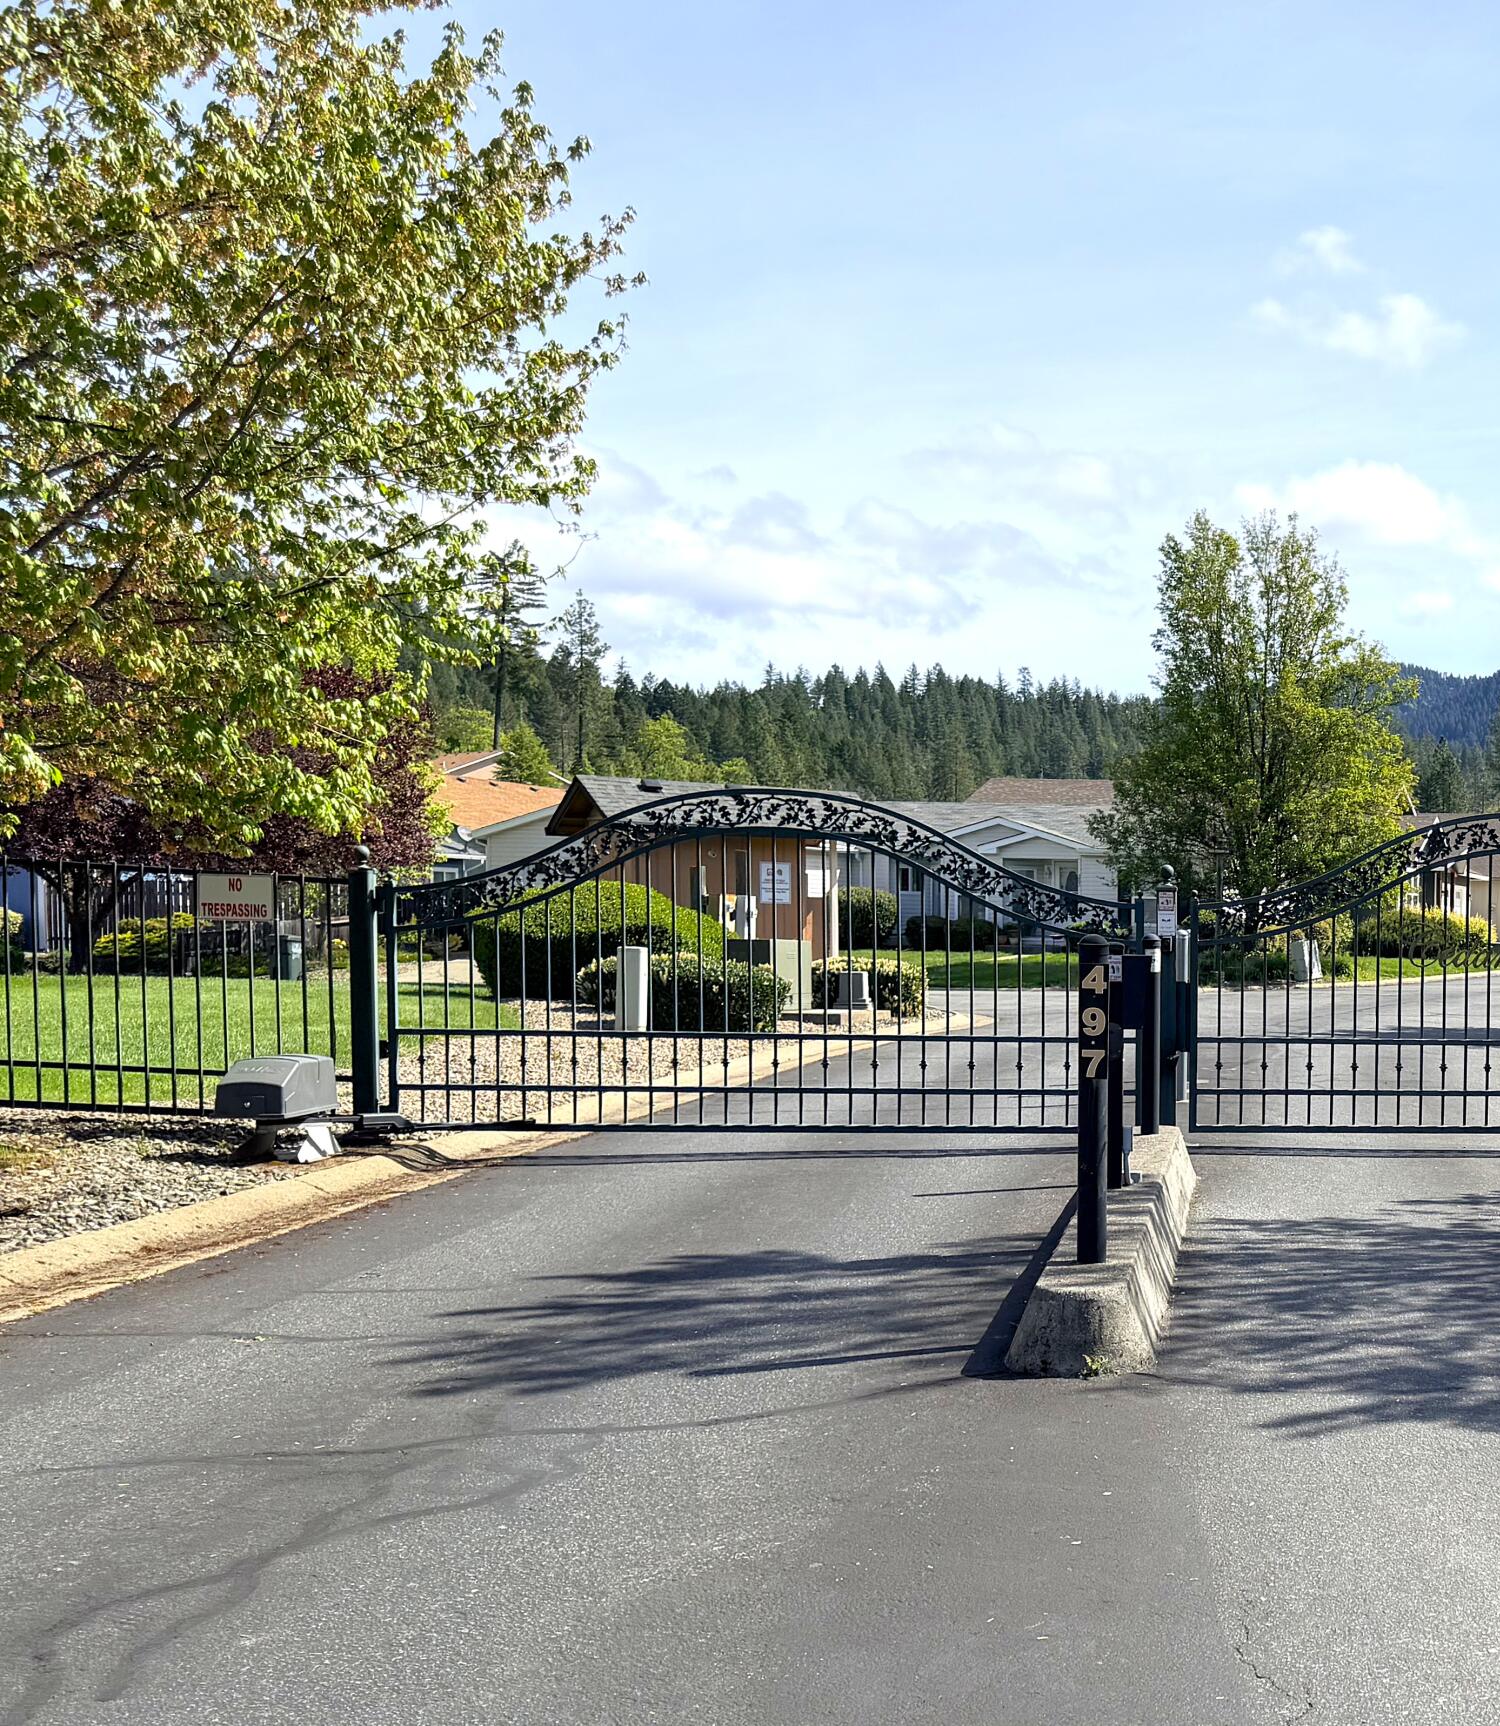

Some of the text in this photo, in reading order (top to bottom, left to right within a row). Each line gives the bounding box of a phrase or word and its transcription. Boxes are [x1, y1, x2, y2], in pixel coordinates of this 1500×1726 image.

[228, 878, 242, 892] NO
[201, 902, 267, 917] TRESPASSING
[1081, 965, 1108, 1078] 497
